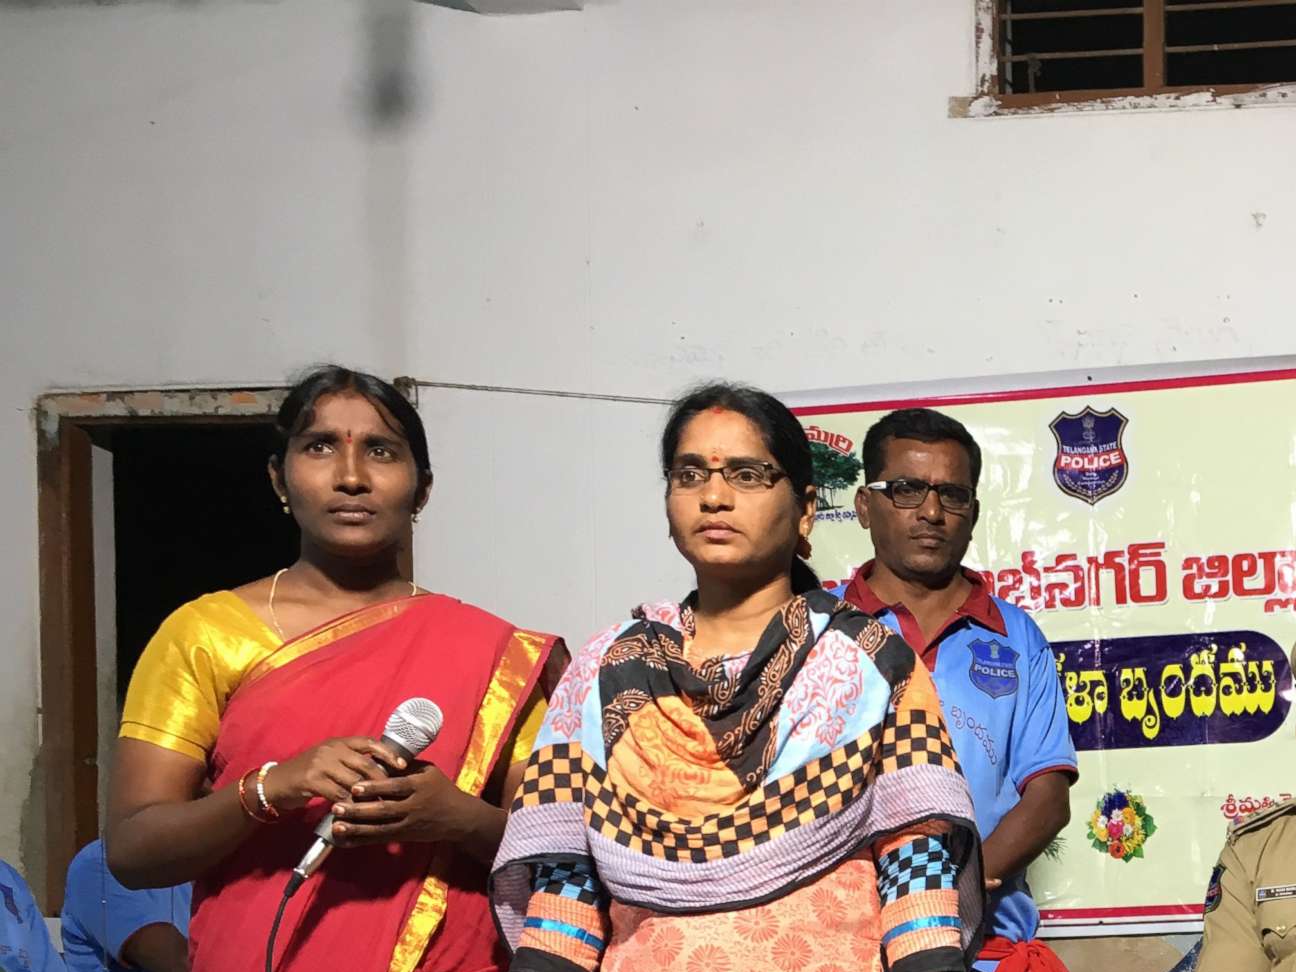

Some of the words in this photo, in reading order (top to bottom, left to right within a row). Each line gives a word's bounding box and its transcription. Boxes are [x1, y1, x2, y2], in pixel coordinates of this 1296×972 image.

[1098, 441, 1118, 453] STATE
[1061, 451, 1123, 469] POLICE
[973, 663, 1017, 679] POLICE
[1120, 641, 1276, 740] బృందము
